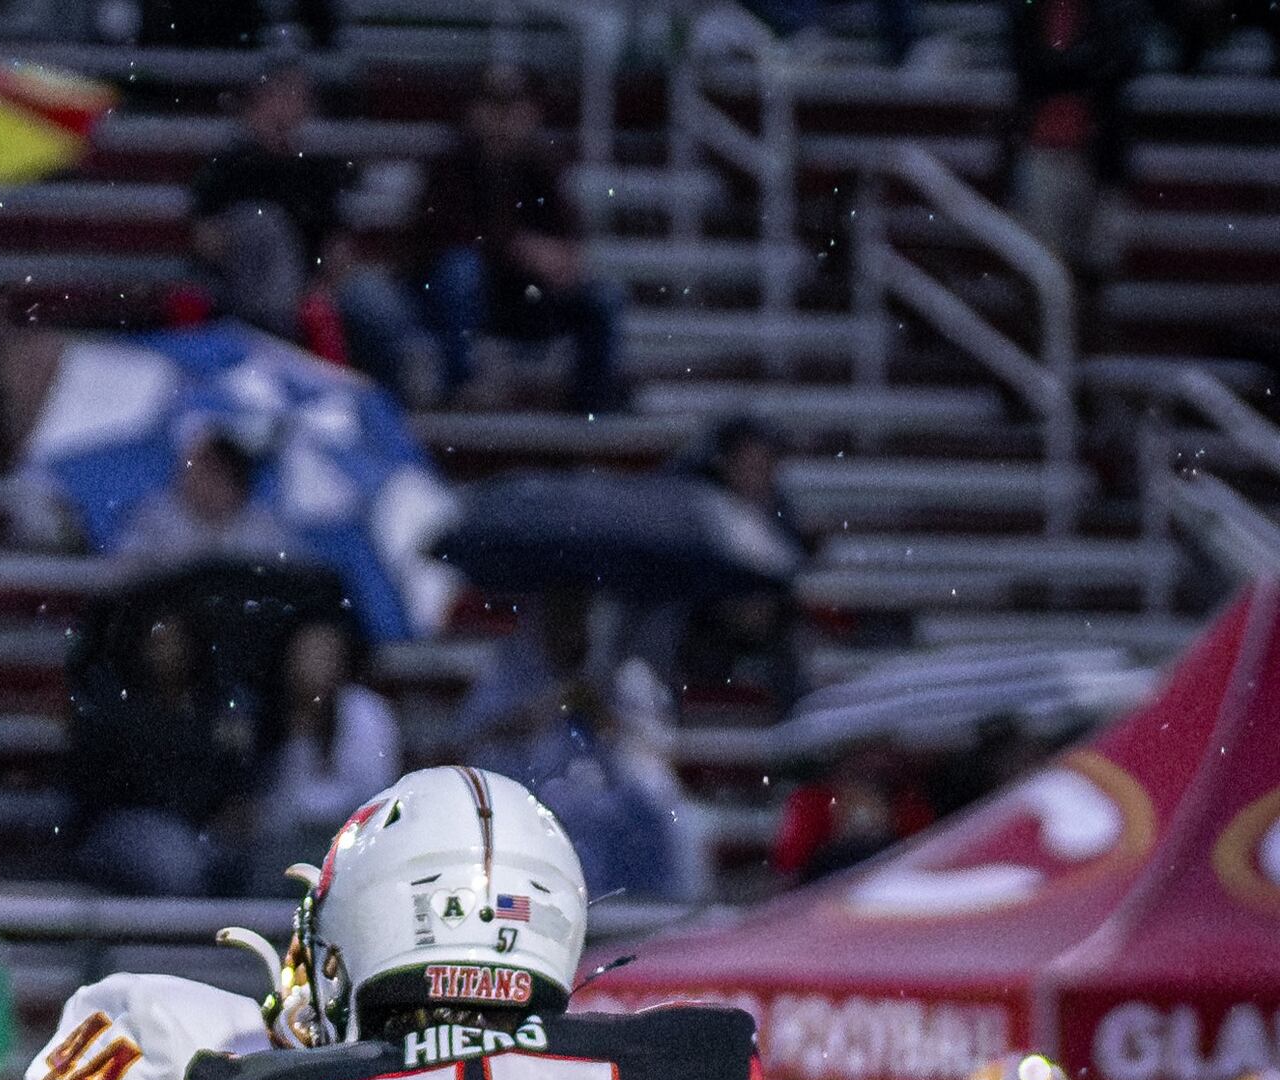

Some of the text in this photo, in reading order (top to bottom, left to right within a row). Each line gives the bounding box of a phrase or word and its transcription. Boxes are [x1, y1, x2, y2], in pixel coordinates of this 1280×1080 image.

[443, 896, 465, 918] A
[496, 927, 519, 953] 57
[426, 965, 533, 1003] TITANS
